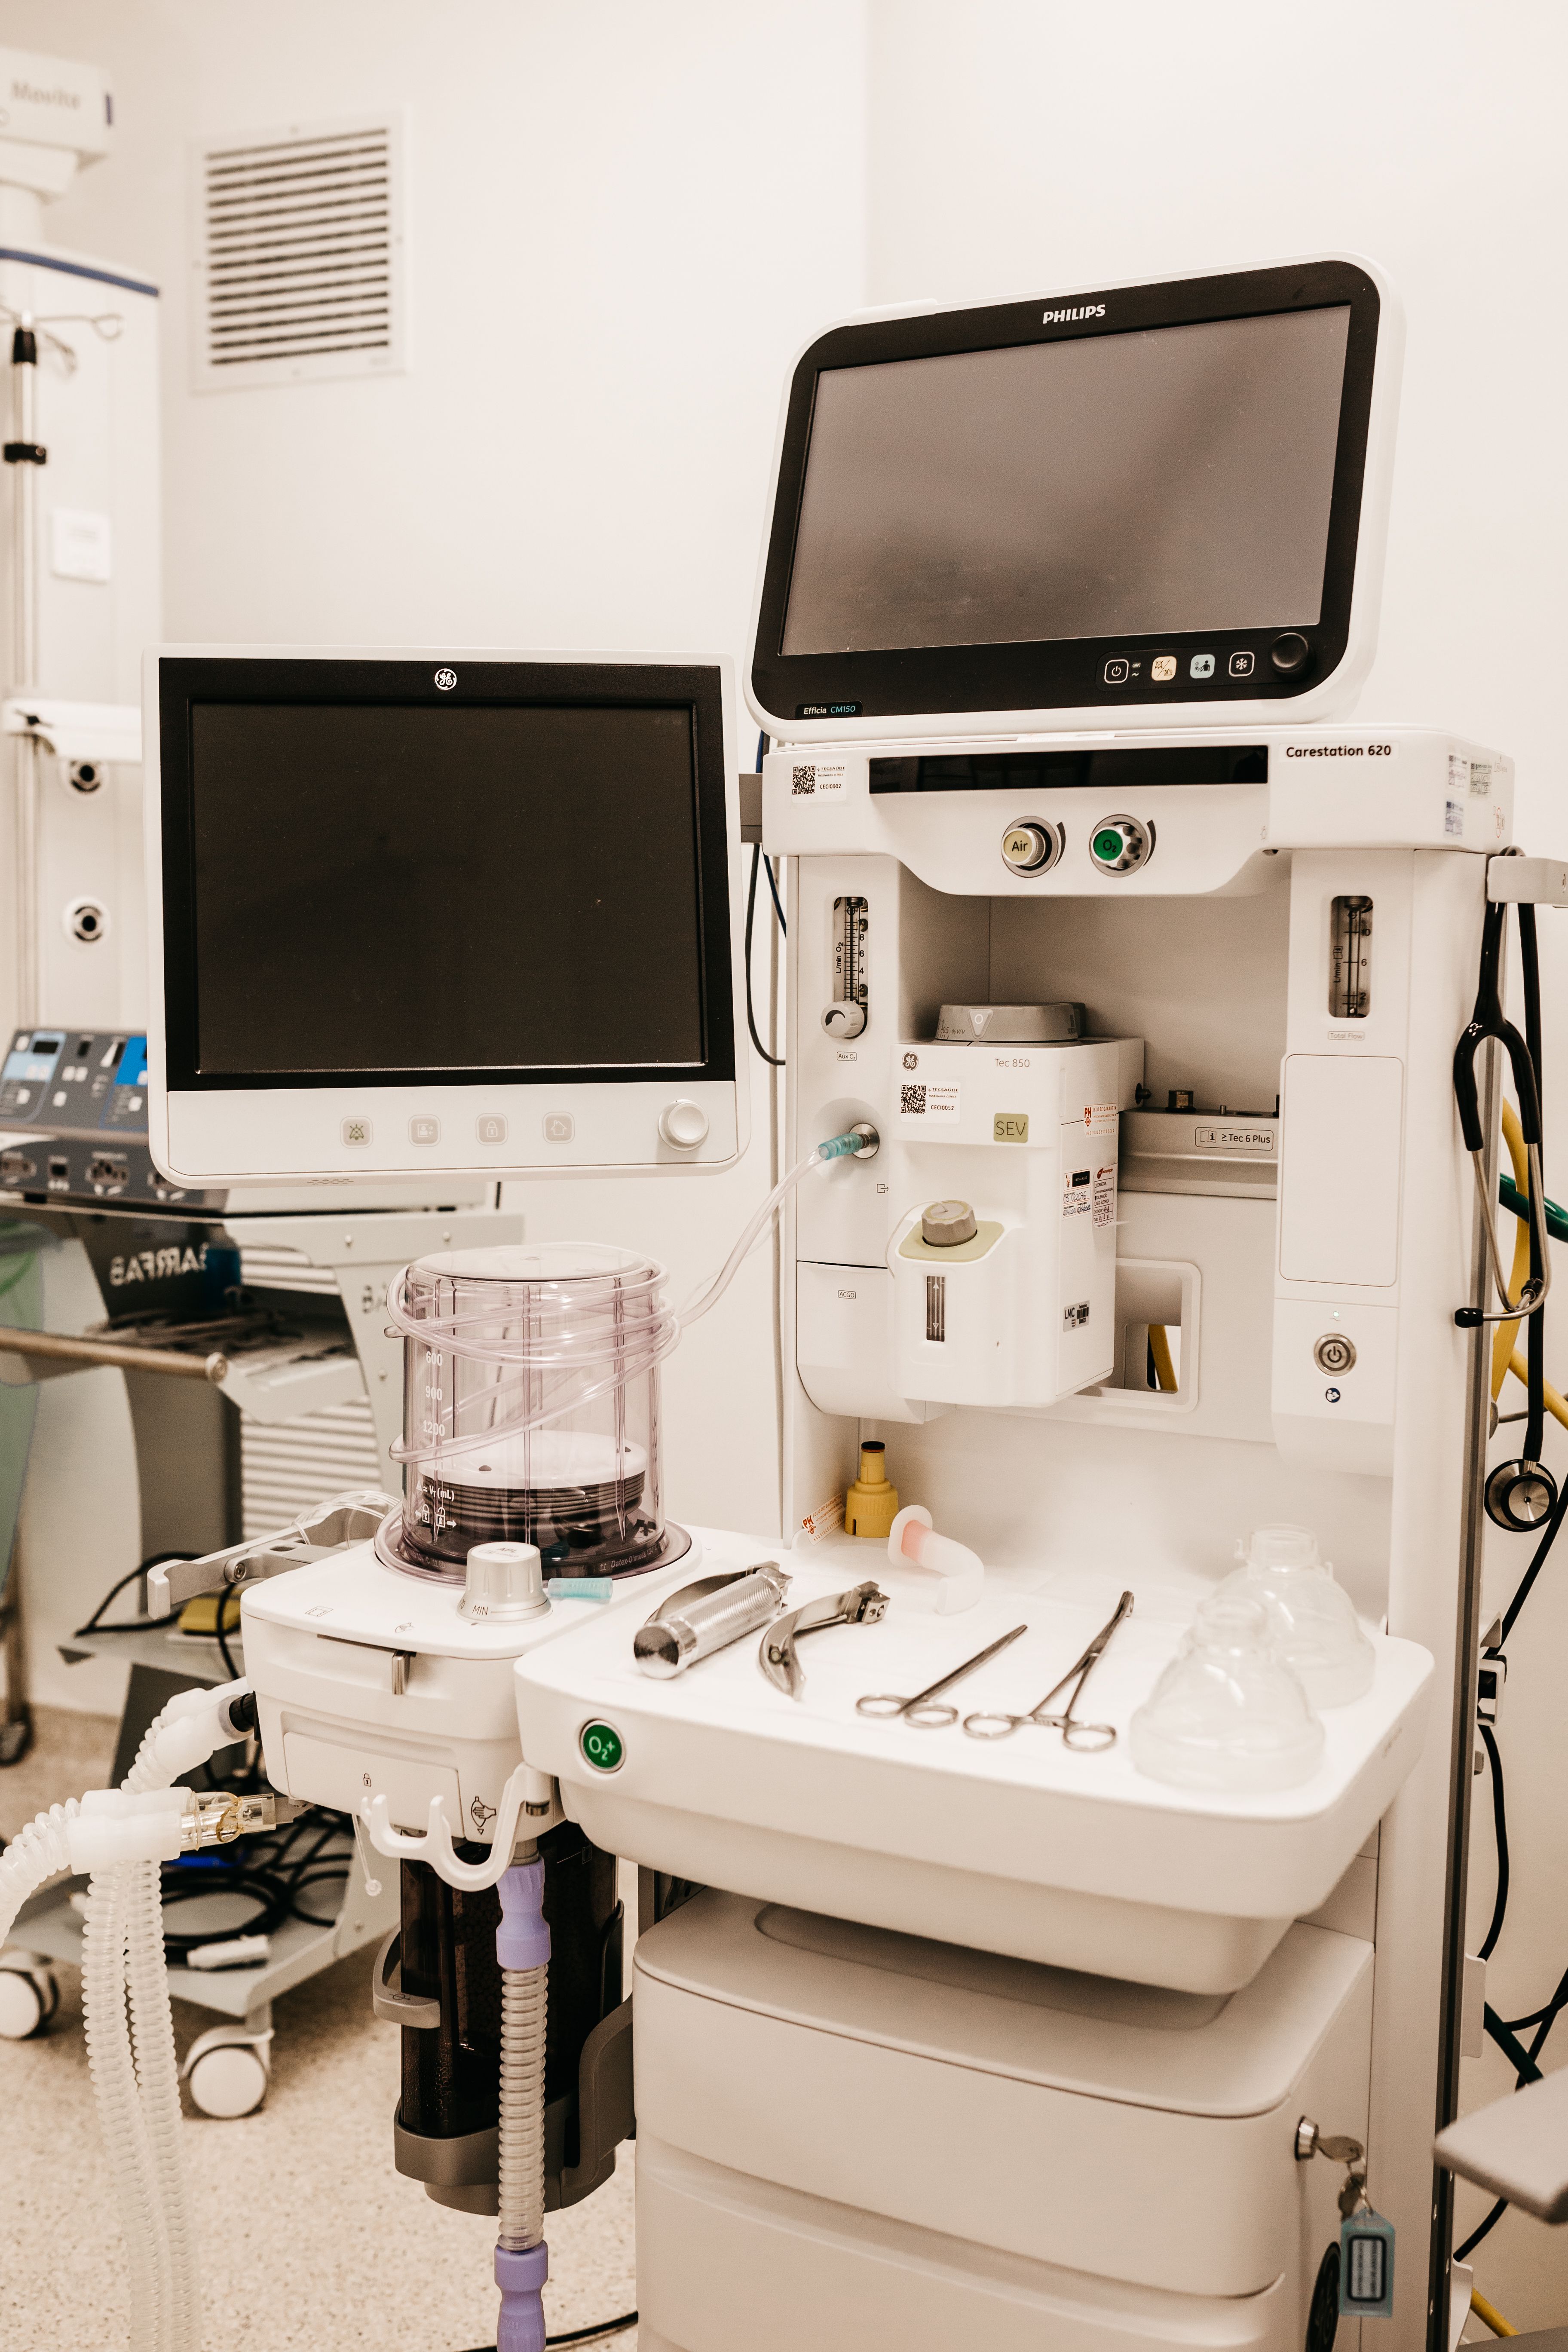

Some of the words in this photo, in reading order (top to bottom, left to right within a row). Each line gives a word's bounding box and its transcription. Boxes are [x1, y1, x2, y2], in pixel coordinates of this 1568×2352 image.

[1043, 304, 1106, 324] PHILIPS
[1286, 745, 1363, 757] Carestation
[1368, 745, 1391, 756] 620
[1012, 840, 1028, 851] Air
[995, 1058, 1009, 1067] Tec
[1012, 1059, 1030, 1068] 850
[1084, 1107, 1092, 1118] PH
[996, 1121, 1026, 1136] SEV
[1253, 1135, 1271, 1143] Plus
[1065, 1307, 1075, 1320] LMC
[426, 1351, 443, 1366] 600
[426, 1385, 443, 1401] 900
[423, 1420, 445, 1436] 1200
[437, 1488, 454, 1502] (mL)
[803, 1515, 814, 1528] PH
[611, 1551, 646, 1568] Datex-Ohmeda
[472, 1605, 488, 1615] MIN
